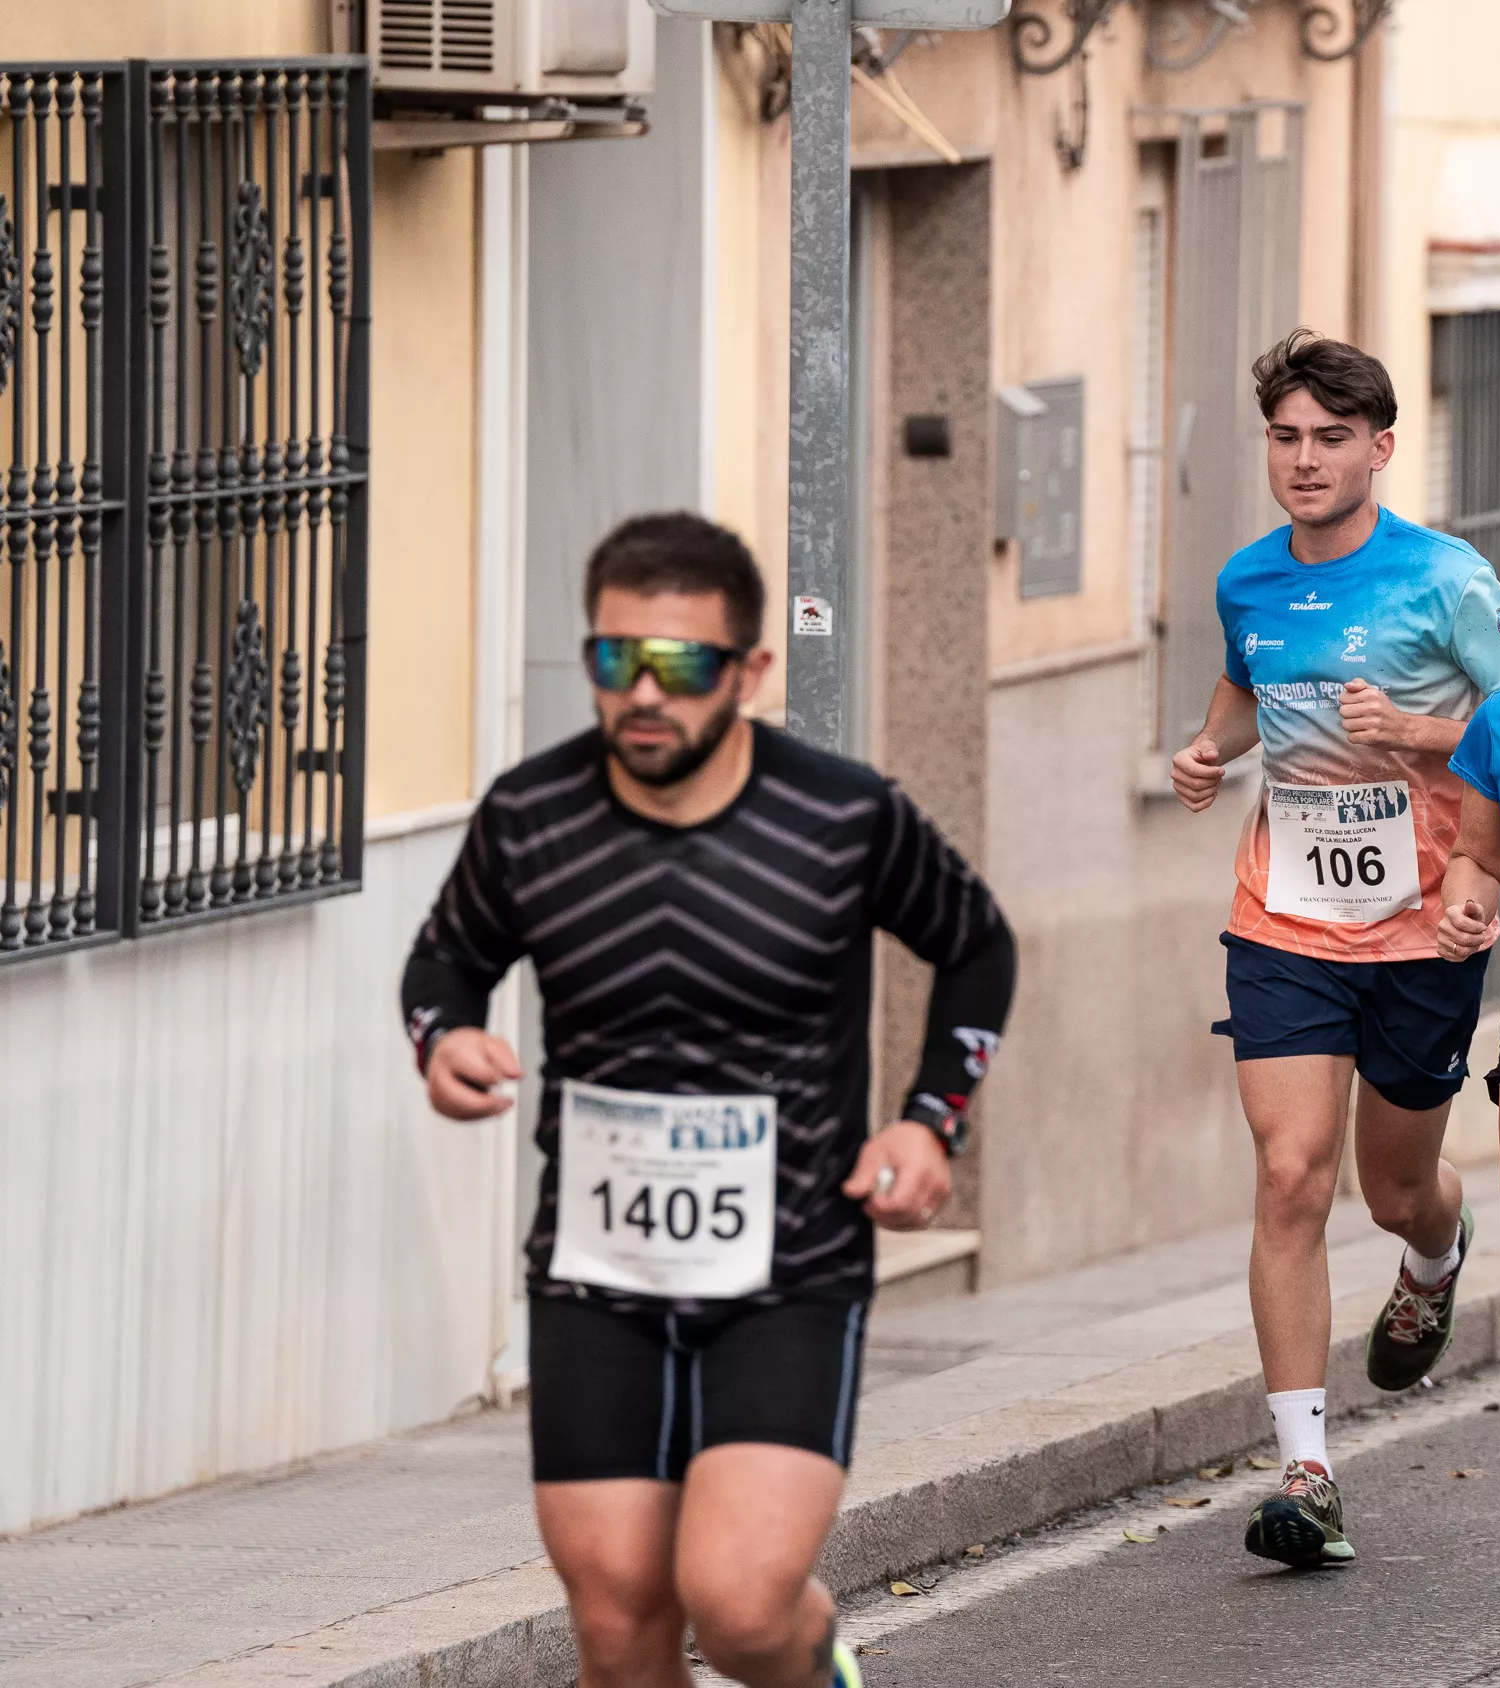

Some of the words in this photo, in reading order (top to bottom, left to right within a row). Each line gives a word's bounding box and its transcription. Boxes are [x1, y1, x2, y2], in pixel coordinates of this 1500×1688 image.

[1288, 602, 1333, 611] TEAMERGY
[1343, 625, 1368, 636] CABRA
[1340, 654, 1367, 663] running
[1266, 681, 1318, 701] SUBIDA
[1300, 796, 1335, 807] POPULARES
[1335, 787, 1375, 807] 2024
[1352, 826, 1377, 835] LUCENA
[1306, 845, 1386, 888] 106
[1299, 895, 1336, 903] FRANCISCO
[1355, 895, 1394, 905] FERNÁNDEZ
[591, 1178, 745, 1242] 1405
